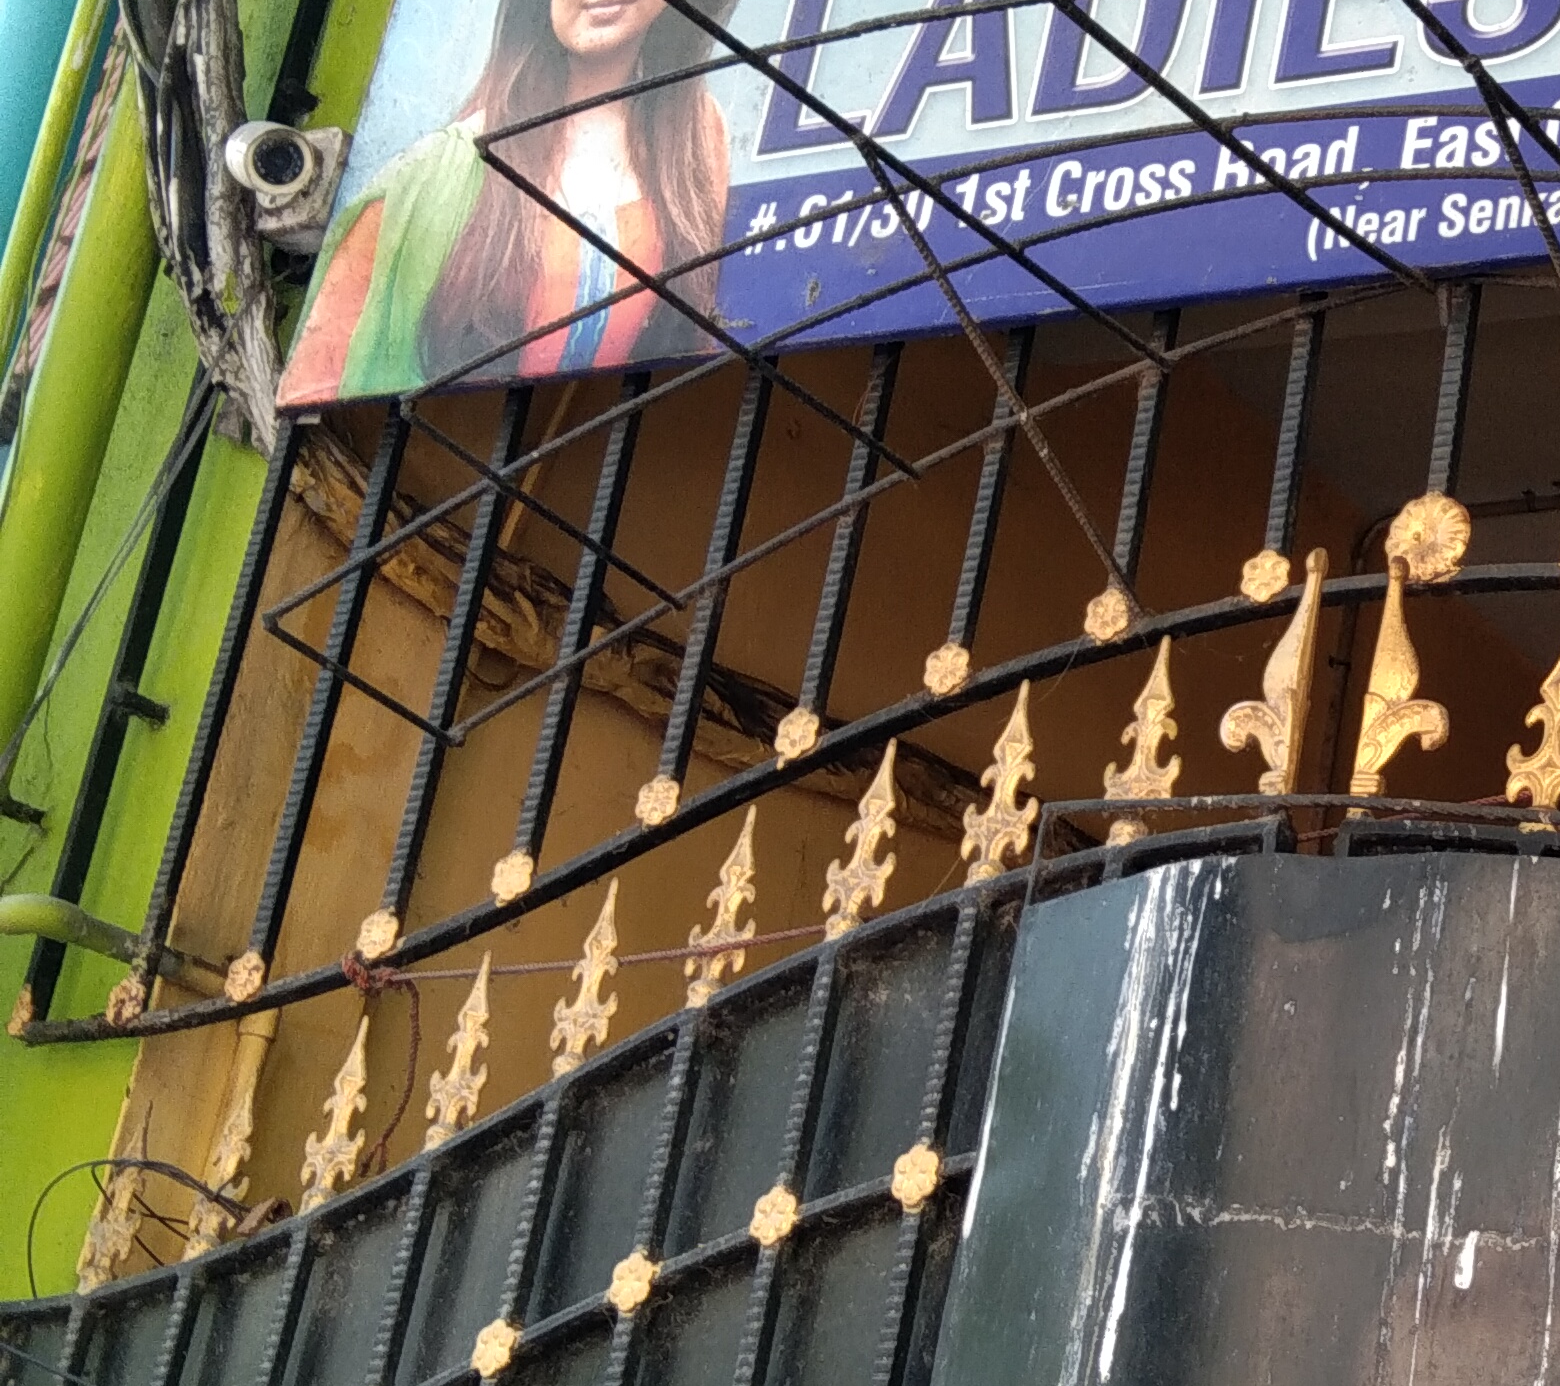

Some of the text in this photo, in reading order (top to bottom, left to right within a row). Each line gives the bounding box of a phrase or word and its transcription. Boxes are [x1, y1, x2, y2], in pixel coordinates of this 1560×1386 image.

[955, 168, 1031, 228] 1st
[1045, 159, 1196, 217] Cross
[1307, 205, 1427, 262] (Near
